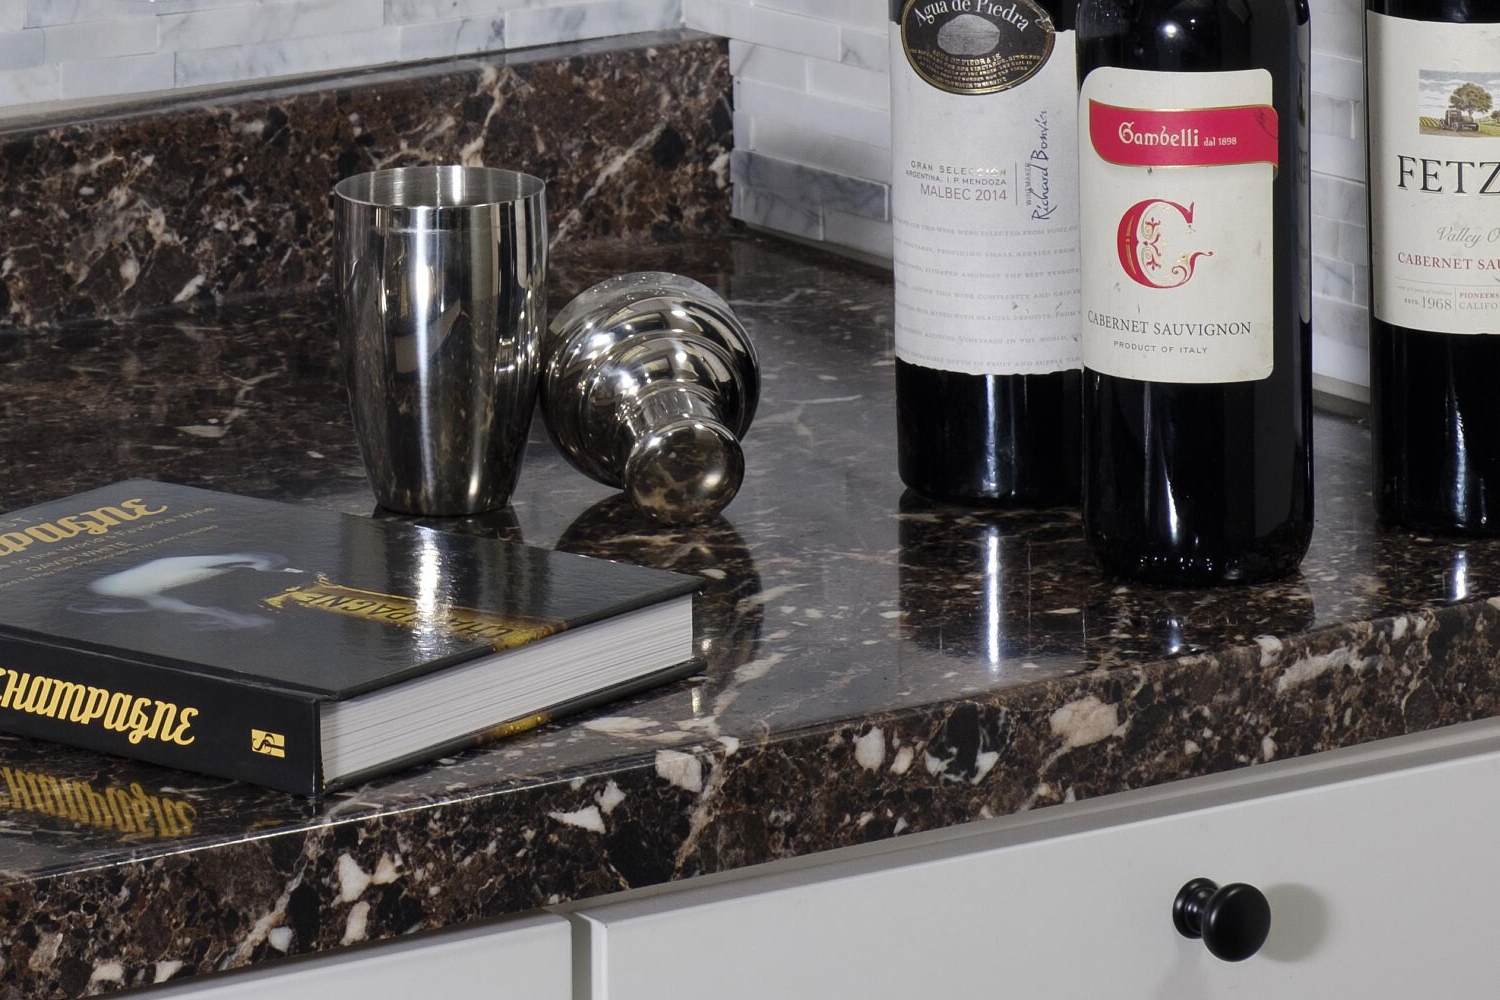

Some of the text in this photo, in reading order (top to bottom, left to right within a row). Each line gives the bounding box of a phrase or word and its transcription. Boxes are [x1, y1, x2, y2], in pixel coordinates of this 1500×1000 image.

[914, 0, 948, 28] Agua
[1118, 121, 1237, 147] Gambelli dal 1898
[910, 160, 933, 172] GRAN
[1397, 153, 1500, 196] FETZ
[962, 178, 1007, 186] MENDOZA
[920, 183, 1008, 201] MALBEC 2014
[1437, 226, 1483, 248] Valley
[1397, 251, 1500, 270] CABERNET SA
[1423, 296, 1452, 311] 1968
[1459, 302, 1500, 311] CALIFO
[1088, 310, 1251, 337] CABERNET SAUVIGNON
[1113, 340, 1156, 353] PRODUCT
[1179, 346, 1208, 354] ITALY
[307, 590, 514, 640] CHAPAGNE
